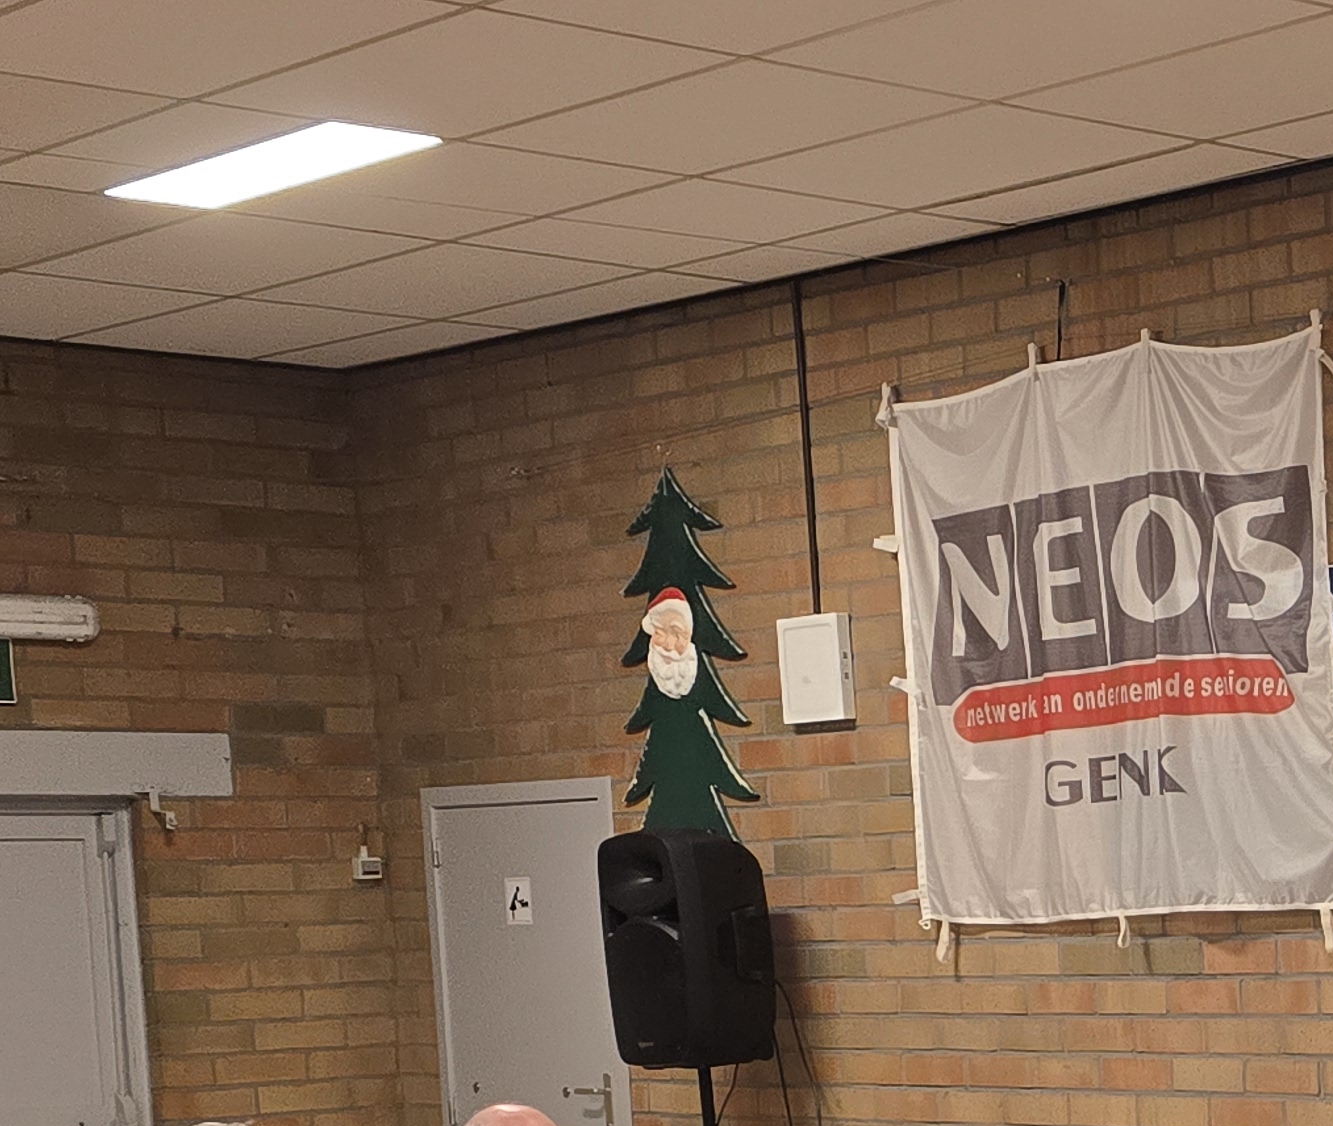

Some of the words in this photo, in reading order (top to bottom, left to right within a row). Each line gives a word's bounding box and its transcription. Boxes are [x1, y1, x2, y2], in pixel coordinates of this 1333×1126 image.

[940, 493, 1304, 657] NEOS
[967, 694, 1037, 727] netwerk
[1045, 745, 1188, 807] GENK
